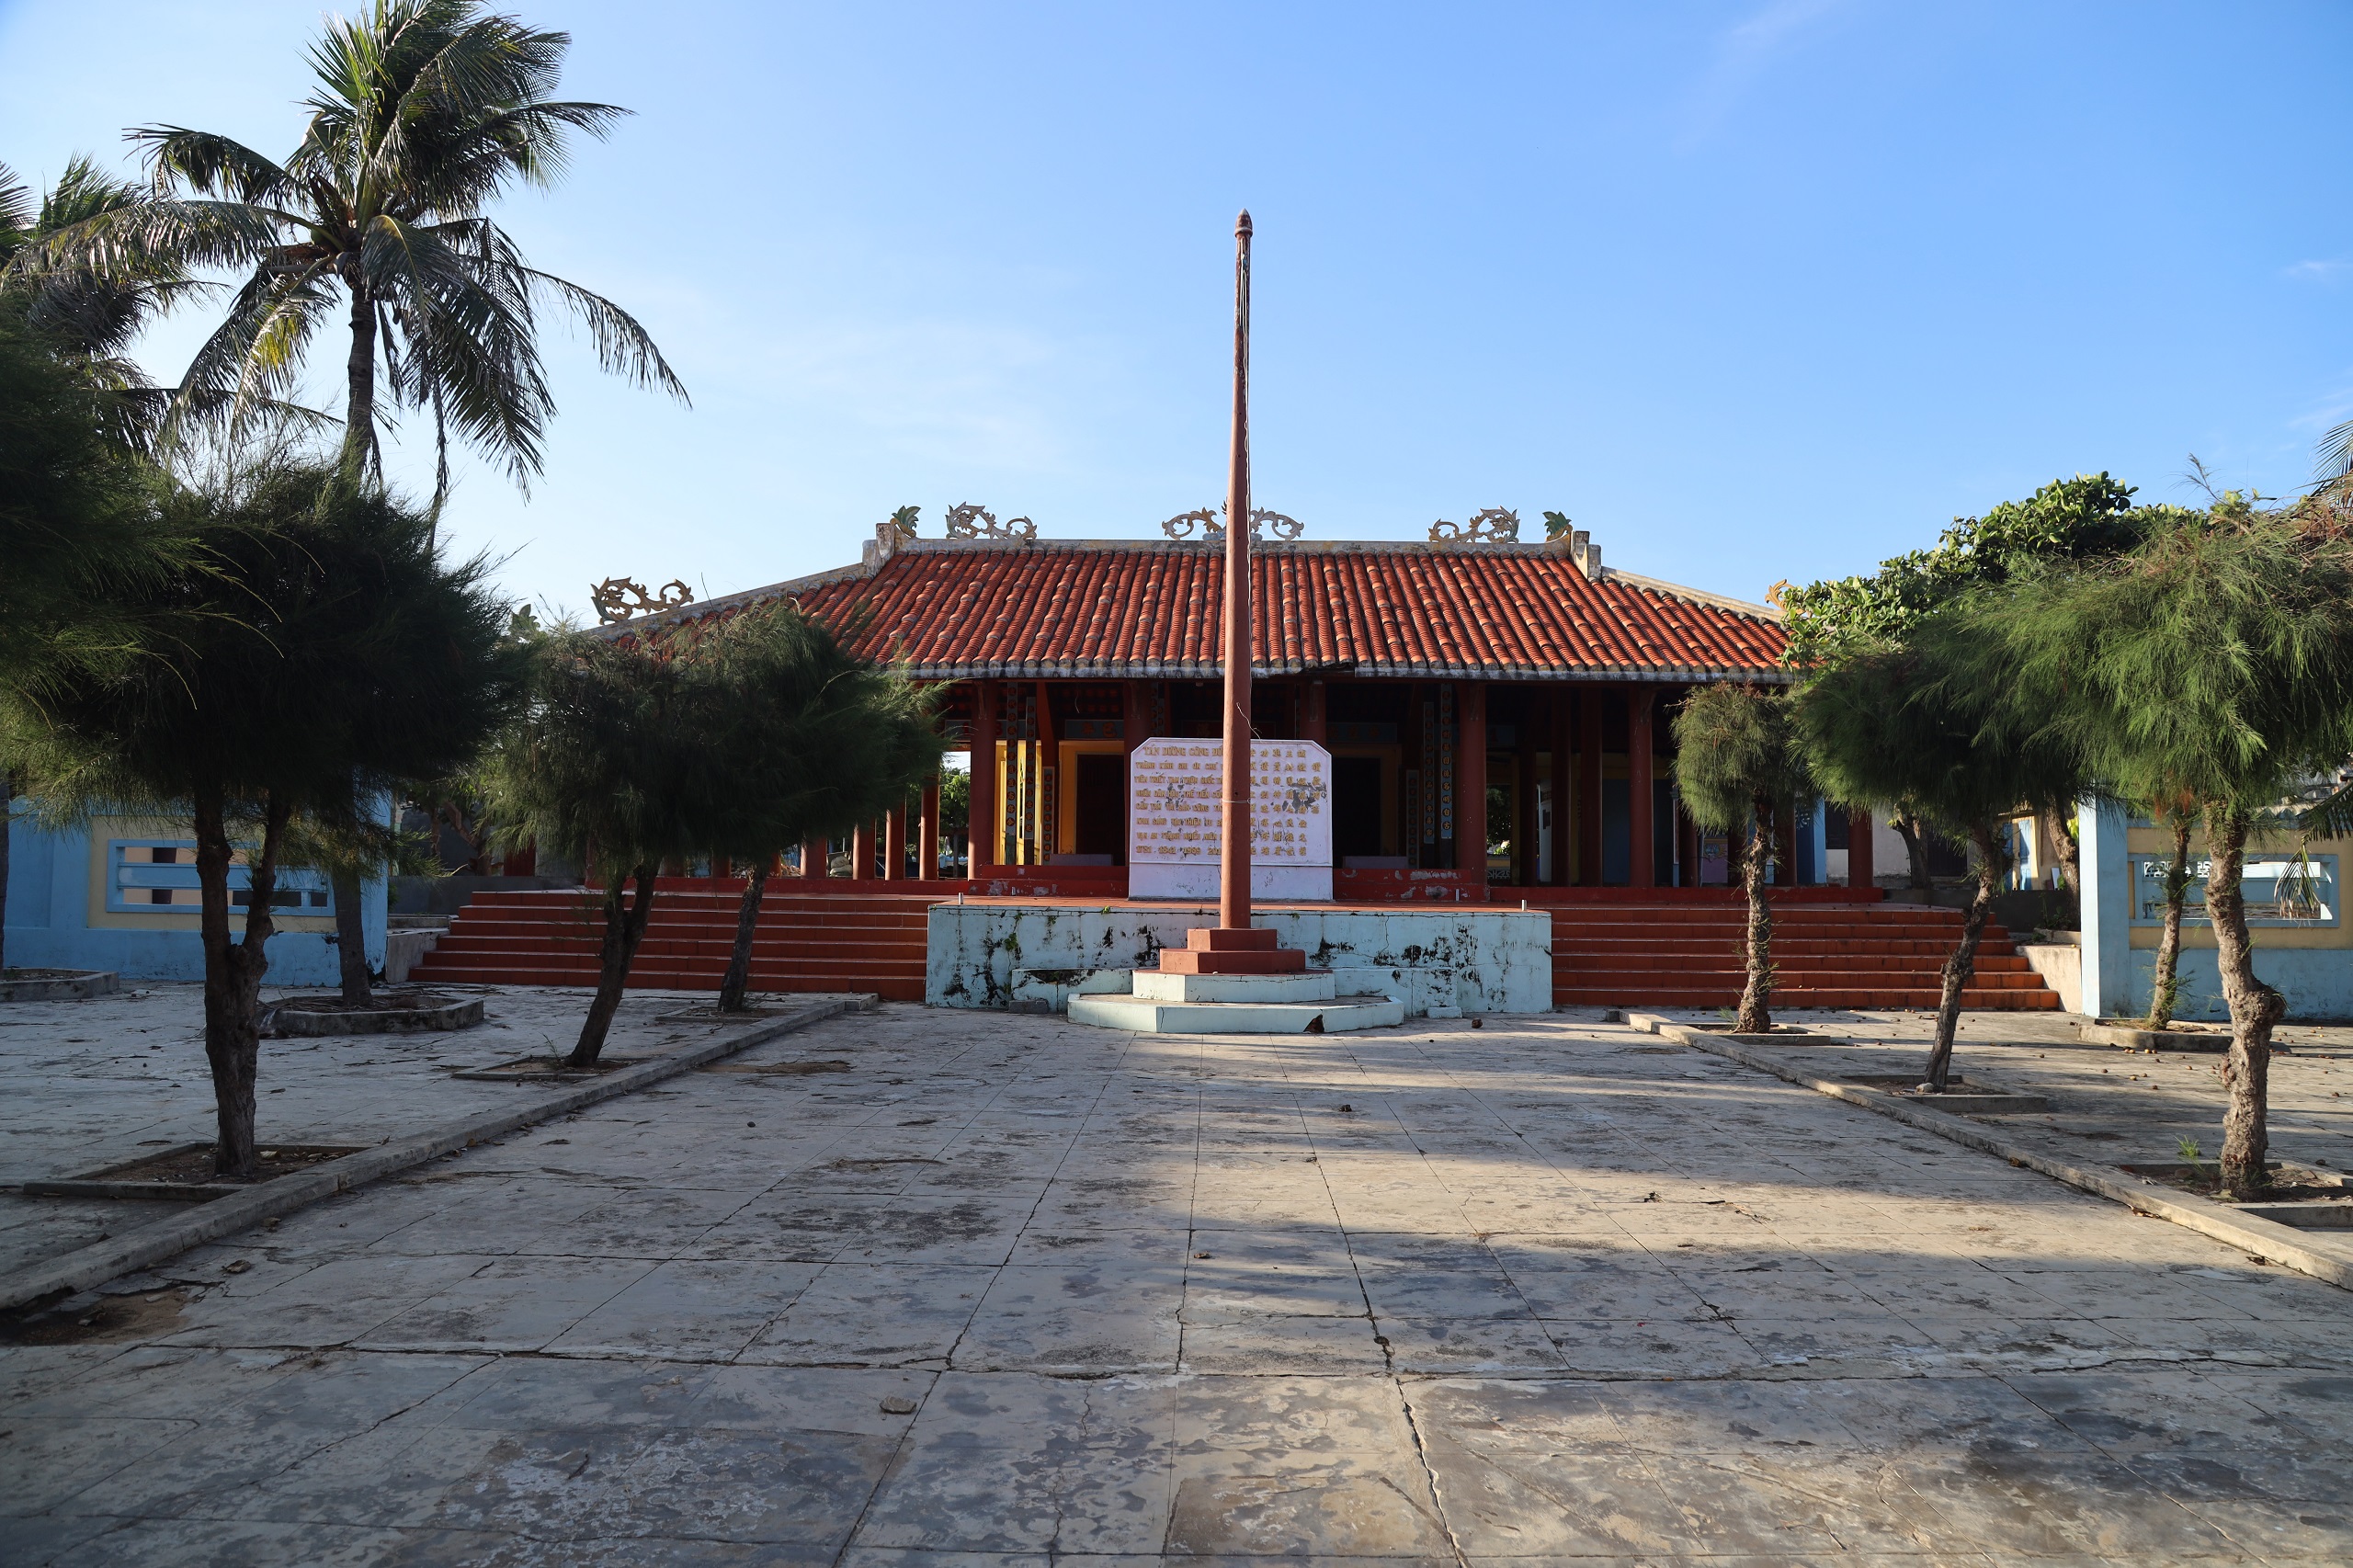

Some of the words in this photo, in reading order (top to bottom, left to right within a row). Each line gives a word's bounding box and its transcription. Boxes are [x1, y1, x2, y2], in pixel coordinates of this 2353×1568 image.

[1143, 744, 1161, 756] TÁN
[1189, 745, 1210, 756] CÔNG
[1211, 744, 1224, 756] ĐỨ
[1135, 789, 1152, 797] NHÂN
[1154, 789, 1165, 797] DÂN
[1192, 803, 1209, 812] CÔNG
[1136, 833, 1148, 841] VẠN
[1208, 846, 1222, 856] 201
